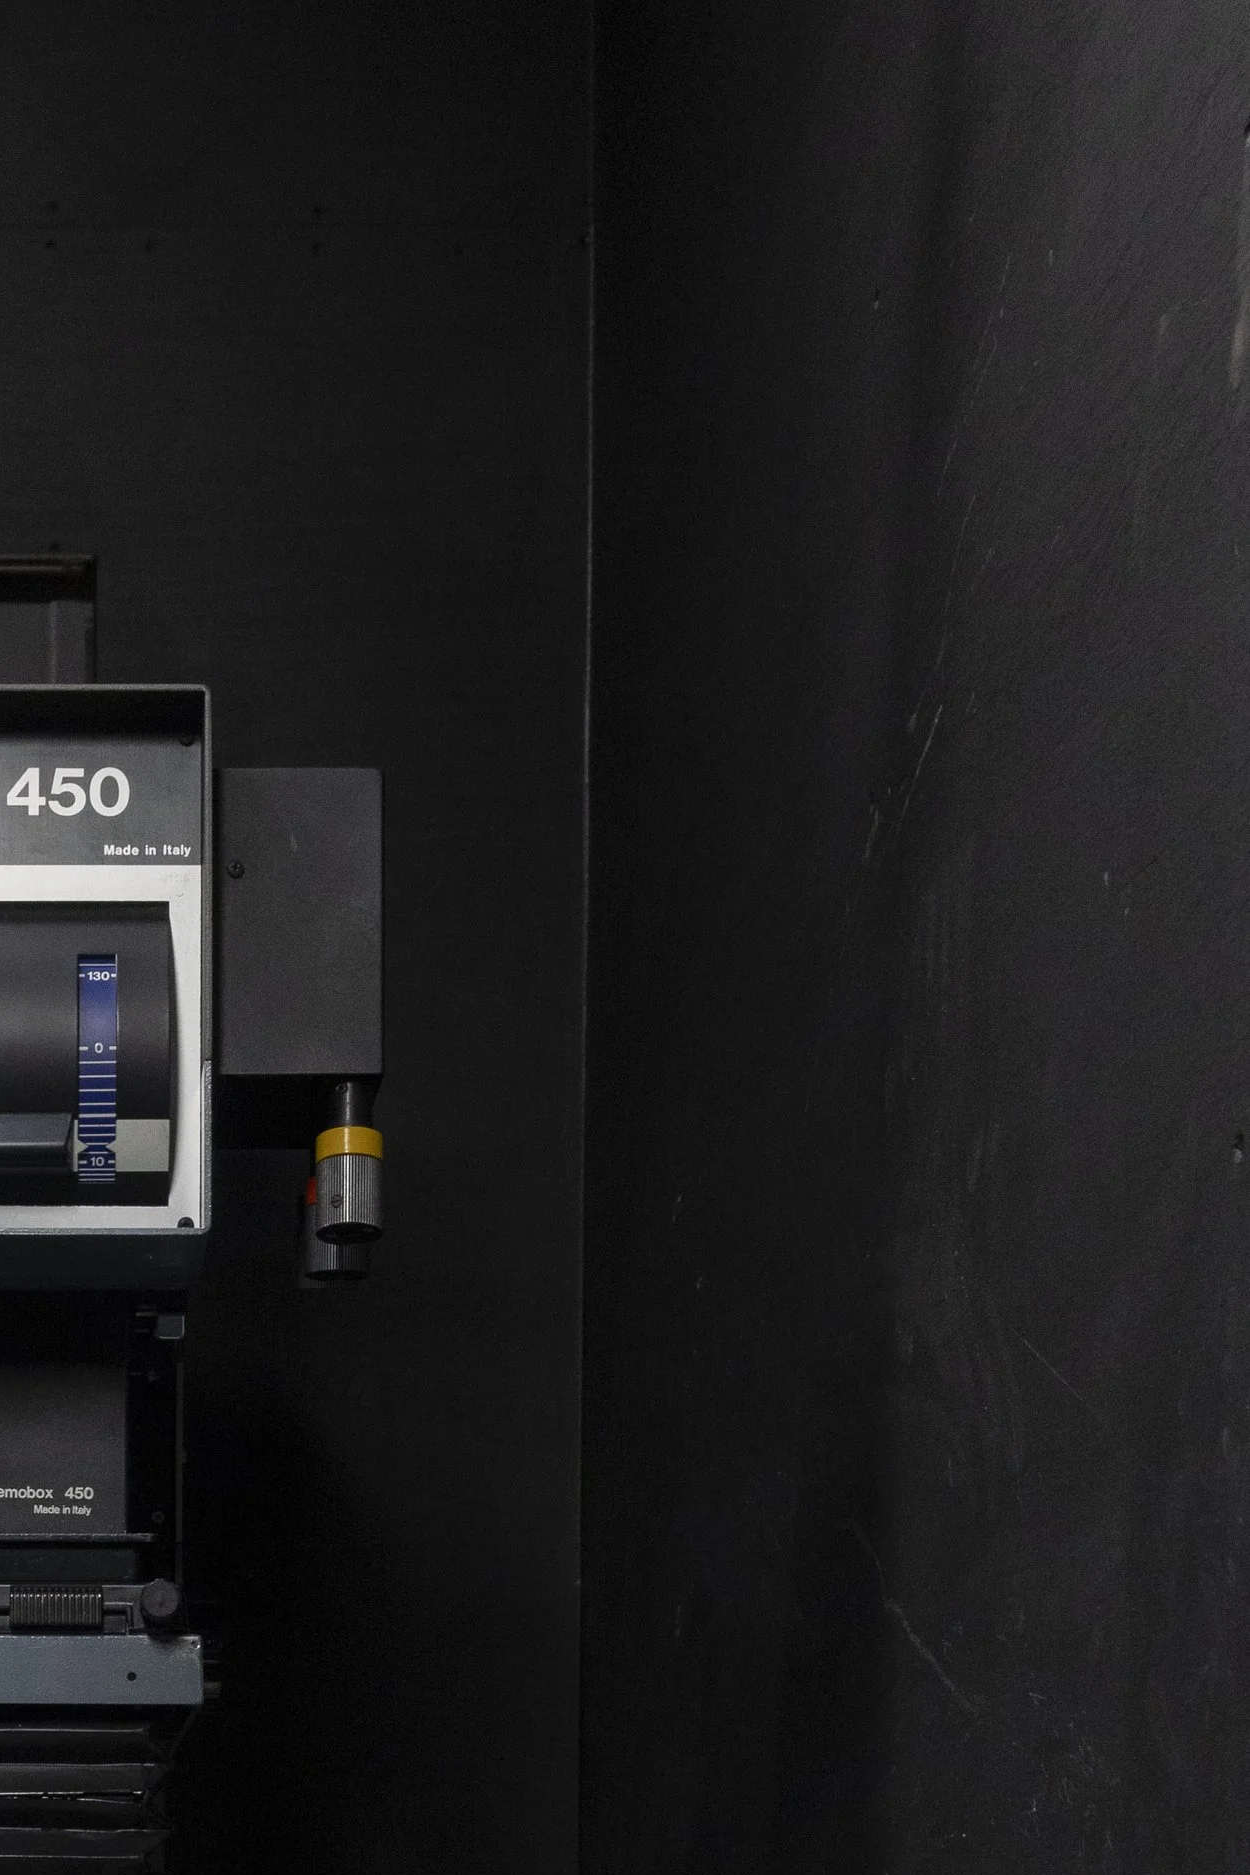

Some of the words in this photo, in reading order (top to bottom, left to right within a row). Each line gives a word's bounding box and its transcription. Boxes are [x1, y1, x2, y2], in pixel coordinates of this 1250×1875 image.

[6, 767, 130, 816] 450
[104, 844, 139, 855] Made
[145, 845, 156, 855] in
[163, 844, 191, 857] Italy
[88, 971, 110, 981] 130
[95, 1043, 103, 1053] 0
[91, 1157, 104, 1166] 10
[65, 1487, 94, 1499] 450
[34, 1505, 60, 1514] Made
[72, 1505, 92, 1516] Italy
